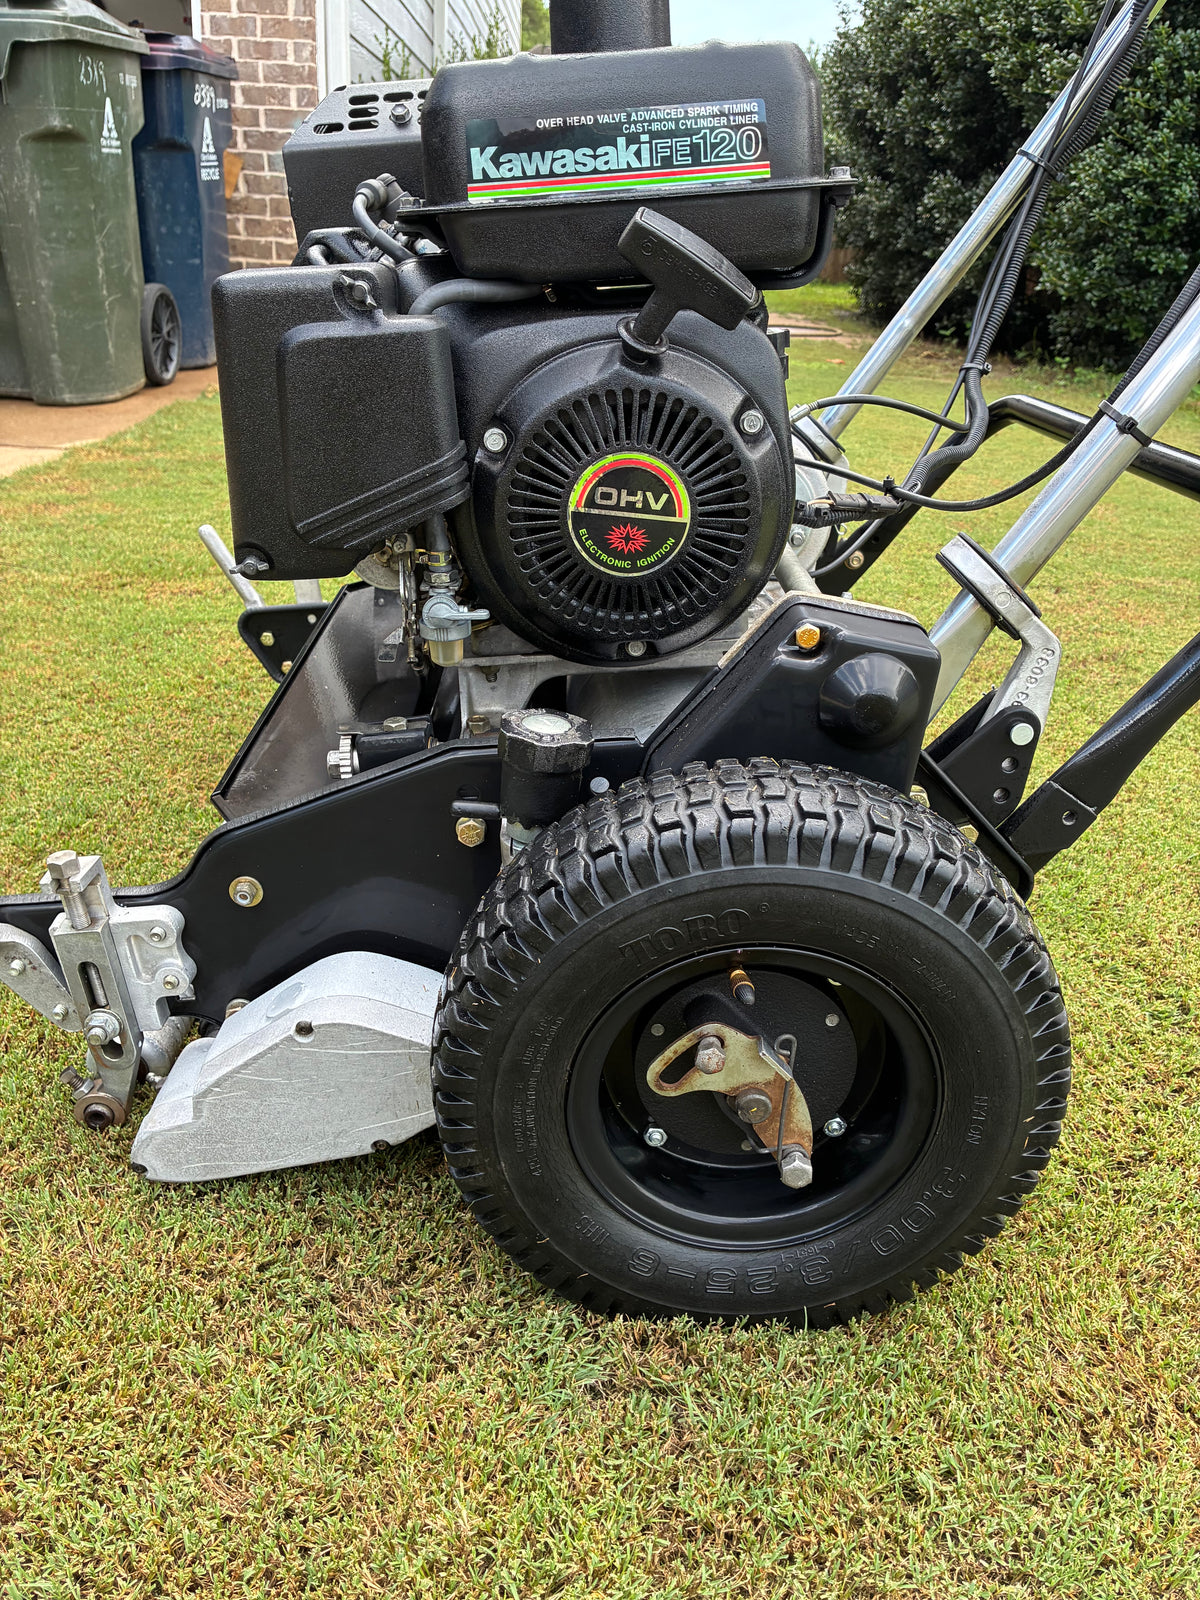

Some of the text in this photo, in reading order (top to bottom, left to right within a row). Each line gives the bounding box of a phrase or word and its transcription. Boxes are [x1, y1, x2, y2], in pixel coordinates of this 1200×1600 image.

[536, 102, 758, 128] OVER HEAD VALVE ADVANCED SPARK TIMING
[622, 114, 758, 134] CAST-IRON CYLINDER LINER
[469, 134, 651, 180] Kawasaki
[594, 486, 670, 511] OHV
[579, 528, 676, 569] ELECTRONIC IGNITION
[618, 908, 751, 967] TORO
[966, 1095, 989, 1146] NYLON
